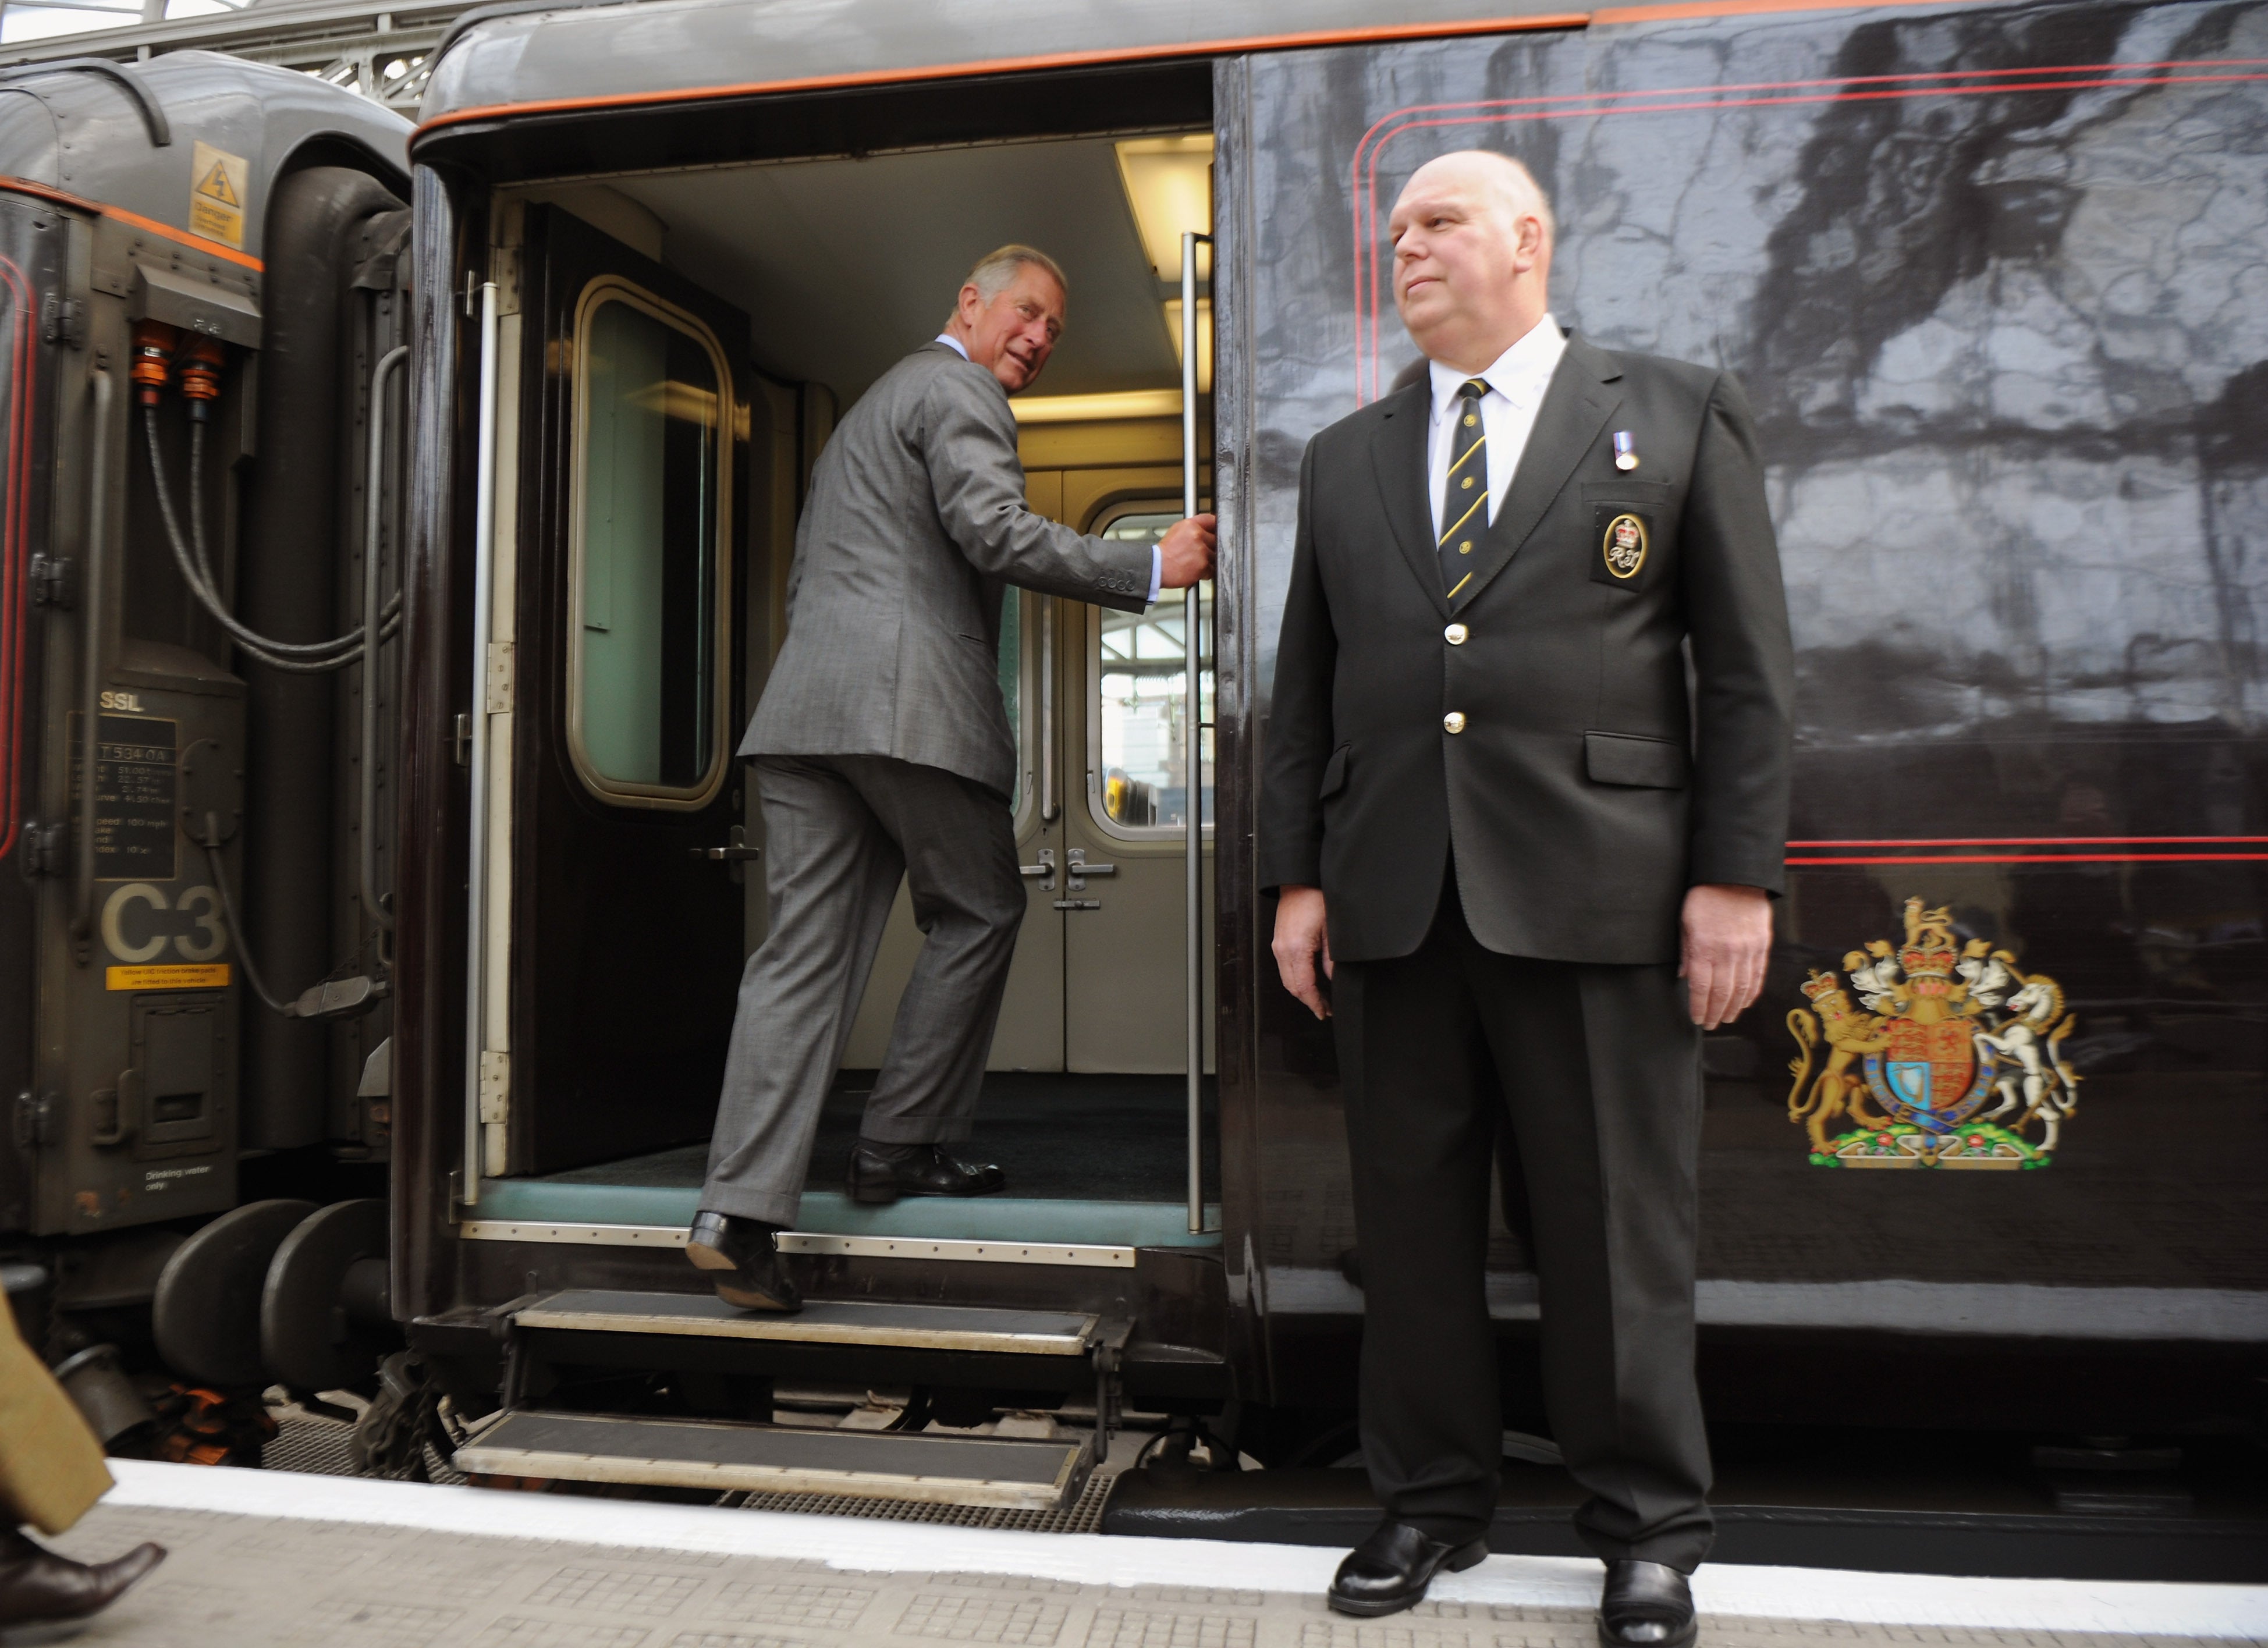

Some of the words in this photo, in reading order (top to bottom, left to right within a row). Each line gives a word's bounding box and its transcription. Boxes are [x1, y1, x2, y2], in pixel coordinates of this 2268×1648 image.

[196, 201, 232, 221] Danger
[100, 691, 144, 712] SSL
[102, 883, 226, 962] C3
[145, 1170, 182, 1180] Drinking
[184, 1166, 210, 1175] water
[145, 1181, 164, 1191] only
